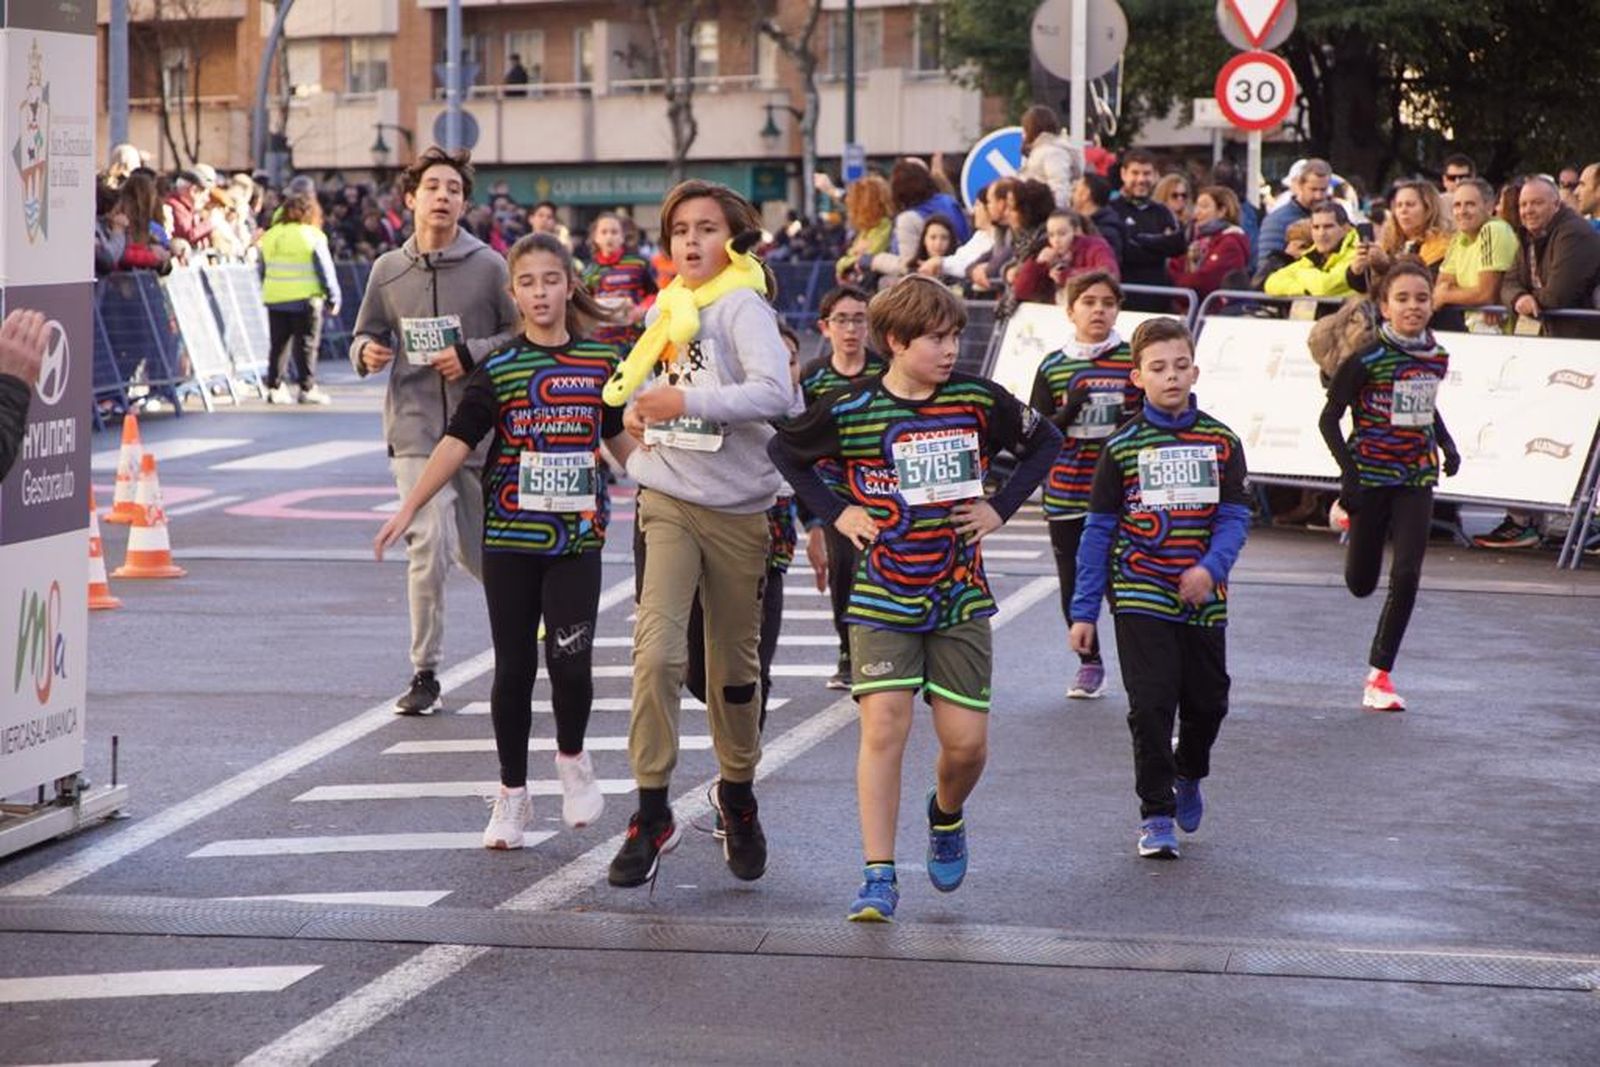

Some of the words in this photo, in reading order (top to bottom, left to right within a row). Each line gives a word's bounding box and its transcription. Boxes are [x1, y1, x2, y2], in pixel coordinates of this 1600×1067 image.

[1235, 79, 1276, 104] 30
[410, 328, 446, 350] 5581
[533, 405, 594, 420] SILVESTRE
[655, 412, 703, 430] 44
[22, 417, 76, 460] HYUNDAI
[916, 438, 970, 454] SETEL
[542, 456, 588, 467] SETEL
[1160, 448, 1209, 460] SETEL
[906, 452, 961, 484] 5765
[1149, 460, 1201, 486] 5880
[22, 464, 75, 506] Gestorauto
[530, 468, 580, 492] 5852
